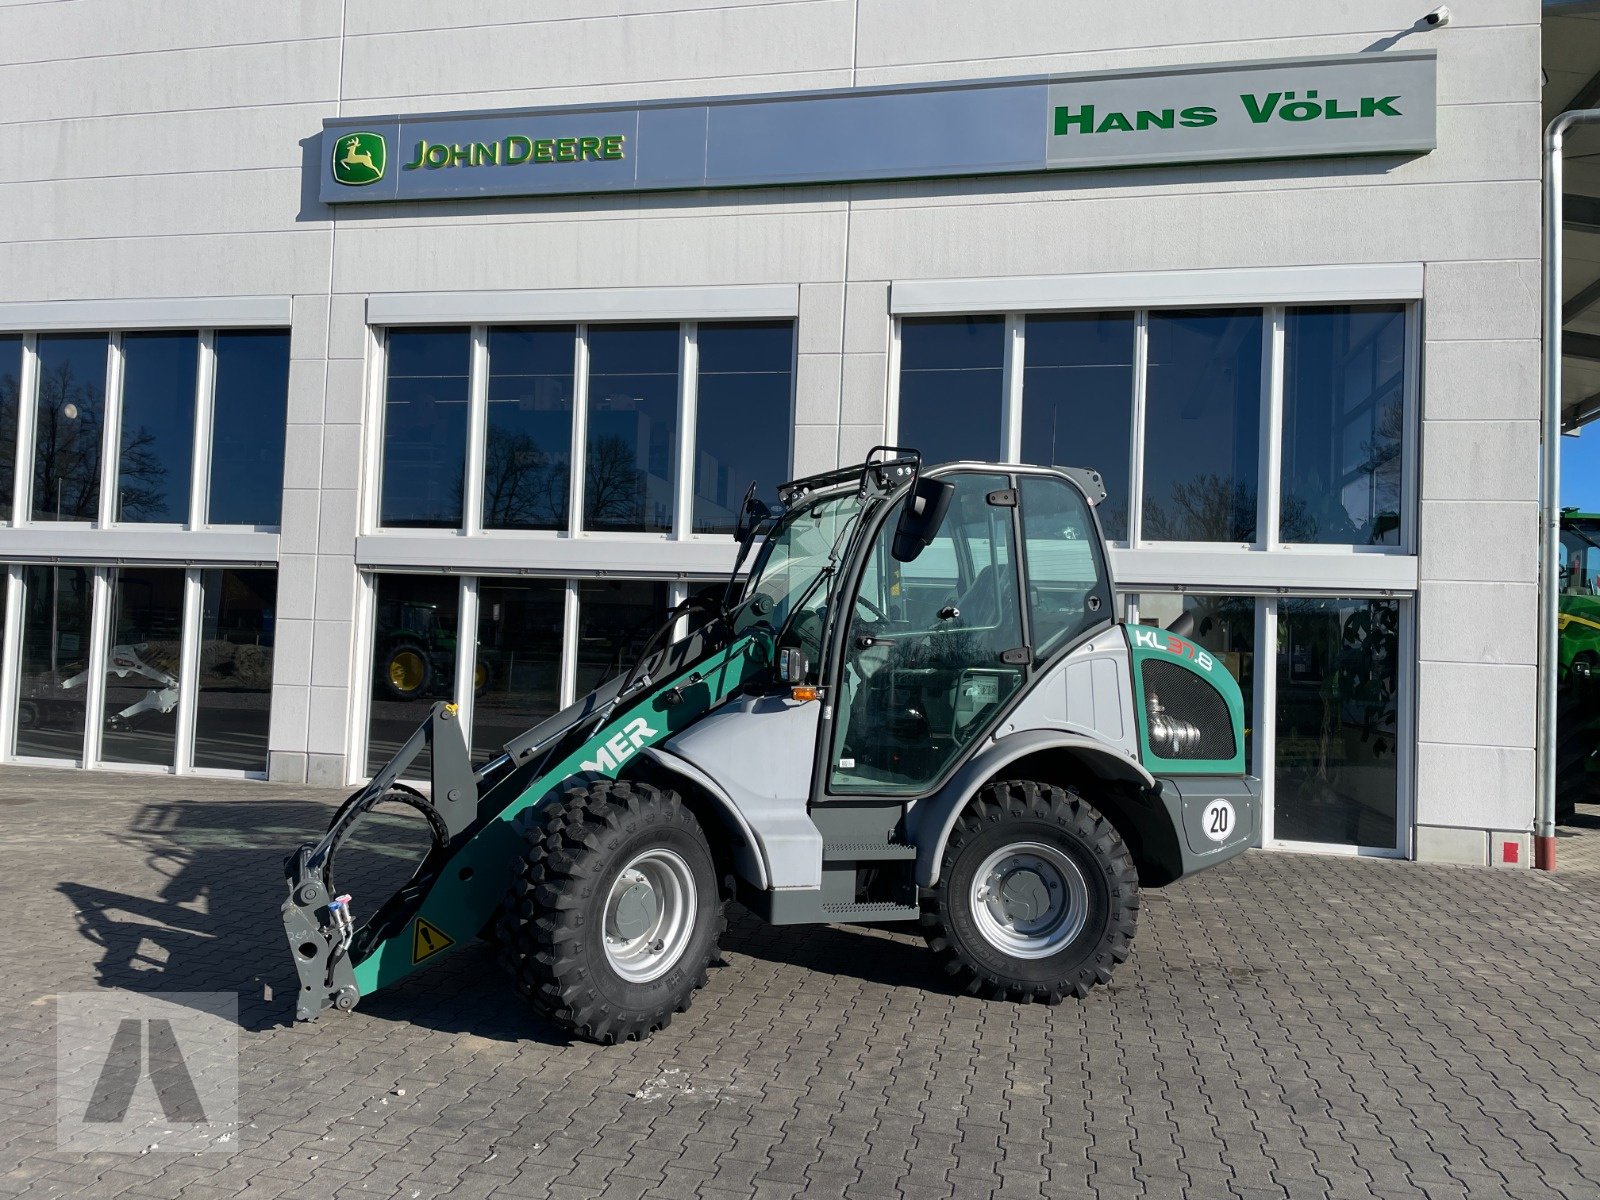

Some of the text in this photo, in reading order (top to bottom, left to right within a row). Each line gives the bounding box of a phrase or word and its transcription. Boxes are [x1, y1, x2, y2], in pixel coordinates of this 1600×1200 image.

[1053, 89, 1403, 136] HANS VÖLK
[405, 134, 626, 170] JOHN DEERE
[1209, 806, 1229, 833] 20
